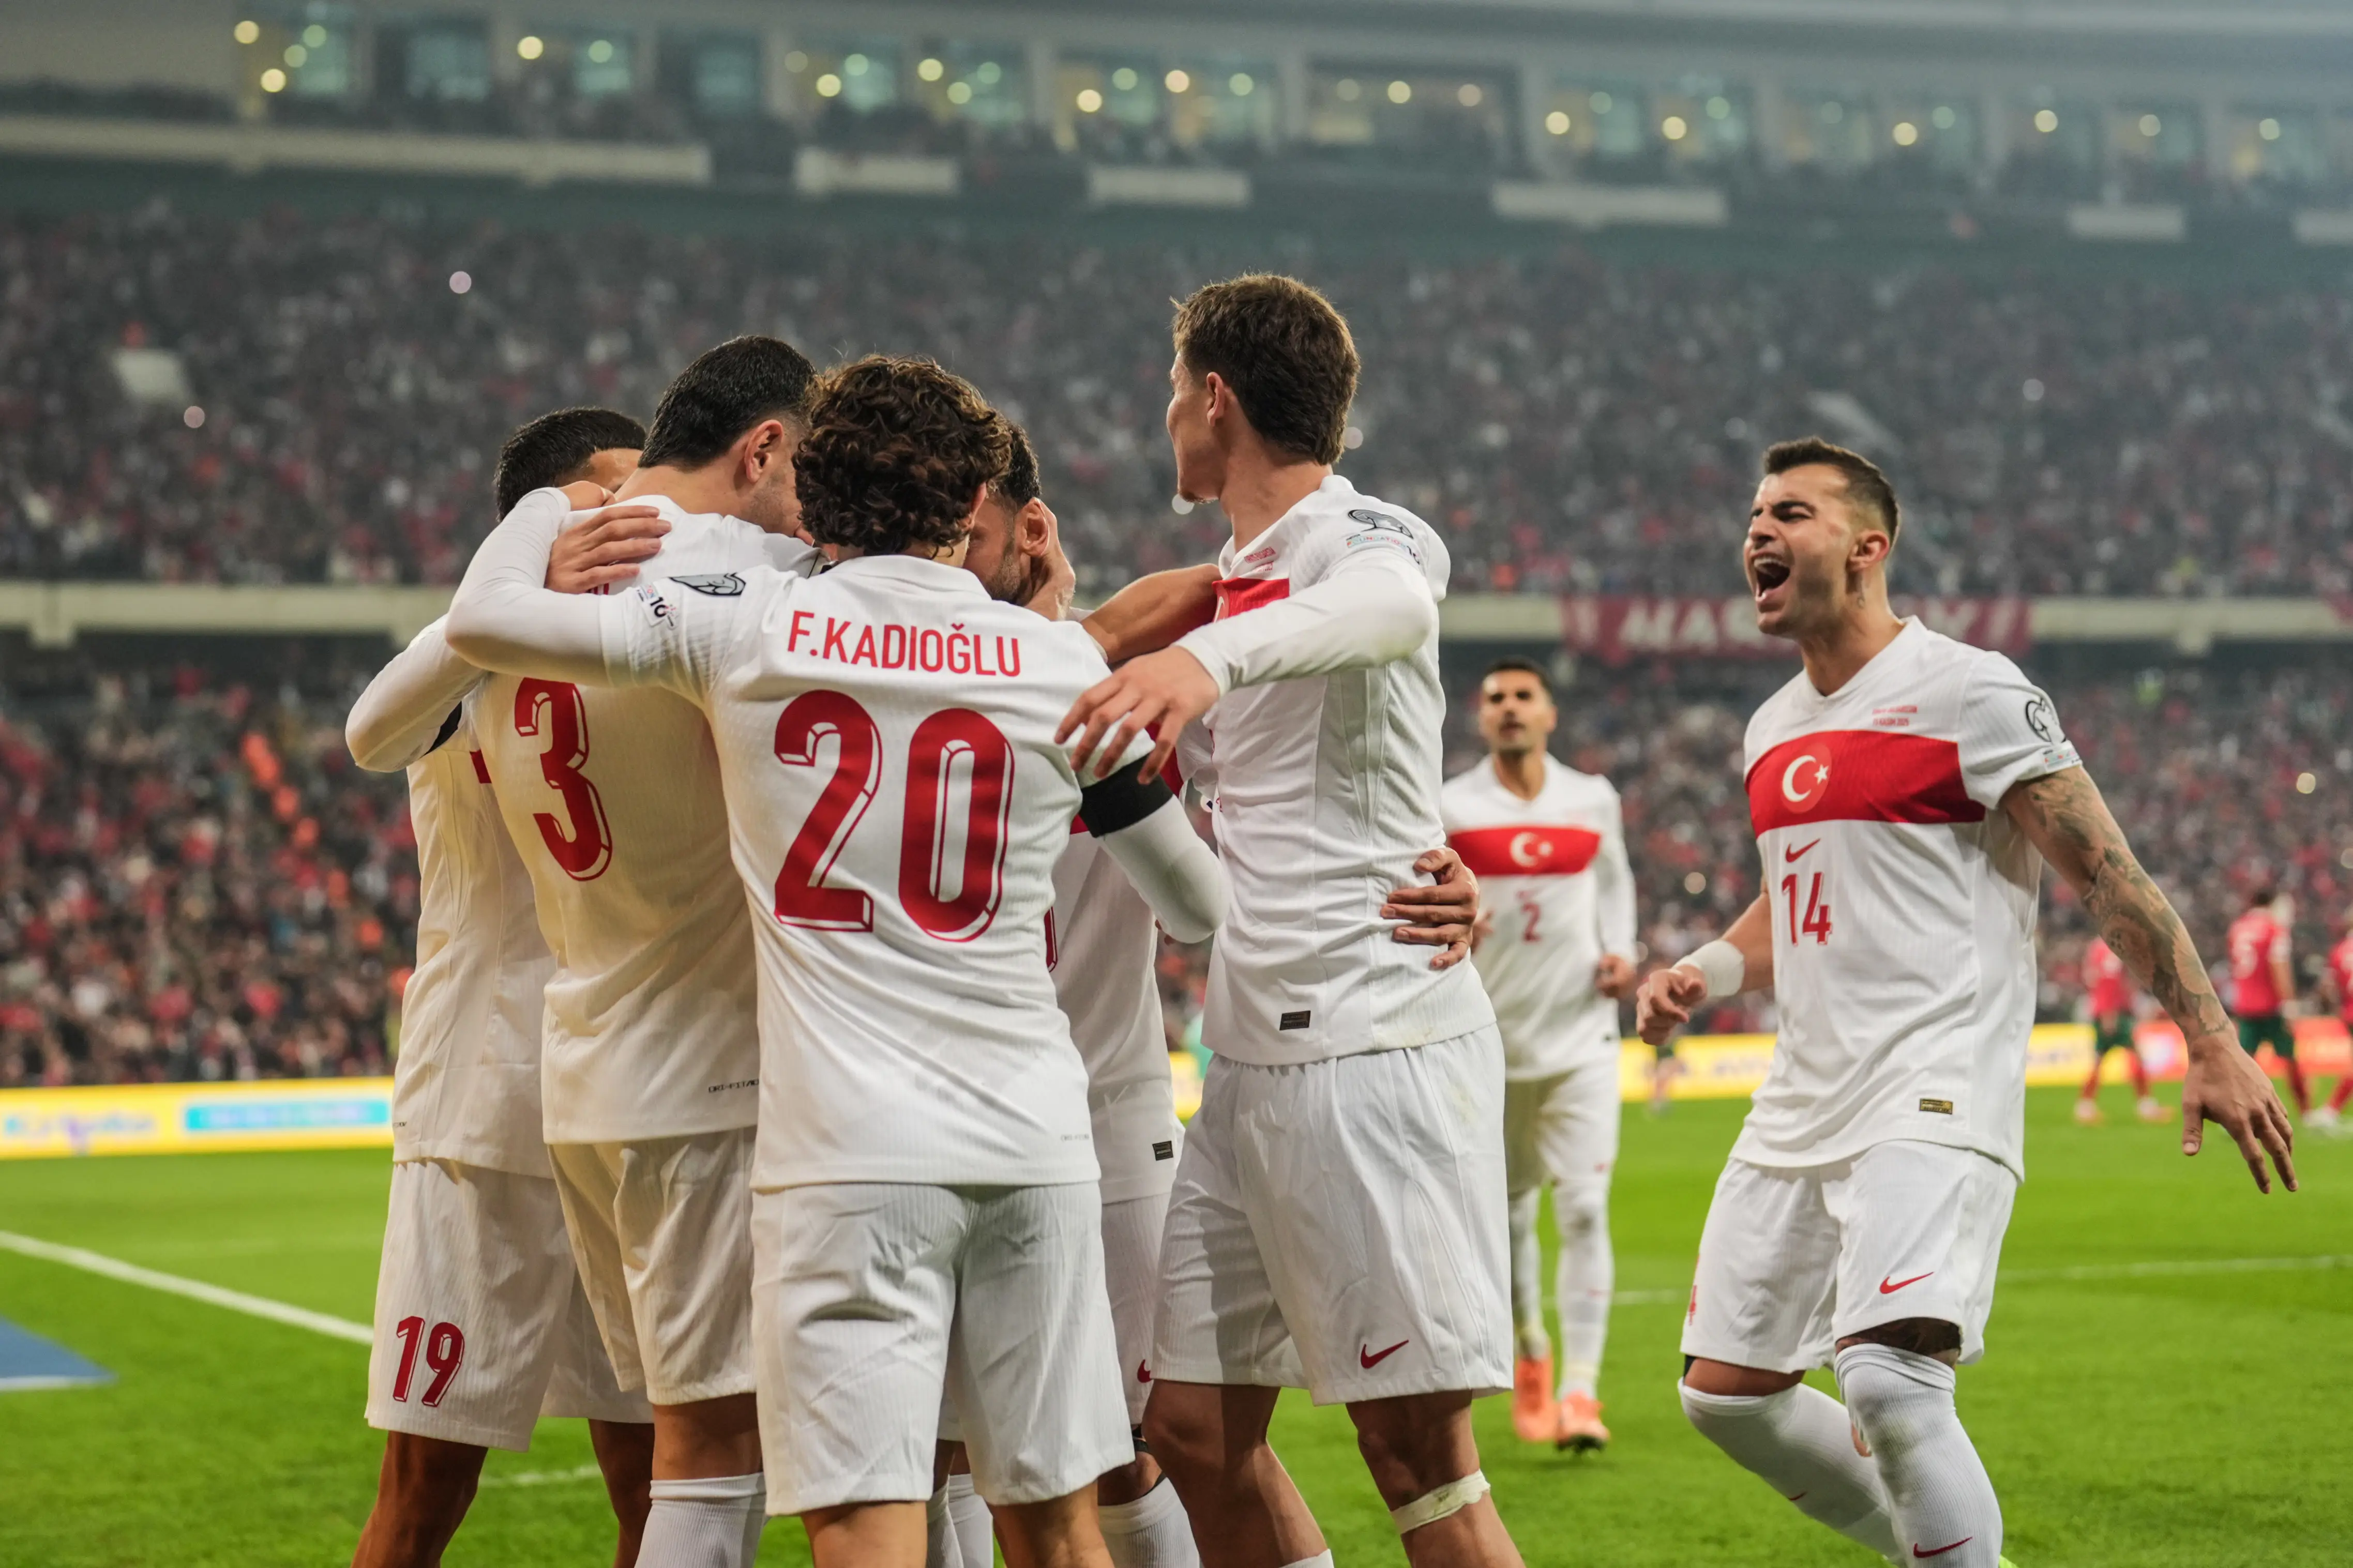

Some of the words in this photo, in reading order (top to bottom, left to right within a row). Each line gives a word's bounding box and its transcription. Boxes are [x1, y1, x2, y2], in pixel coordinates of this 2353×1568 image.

[787, 610, 1021, 677] F.KADIOĞLU
[514, 677, 613, 881] 3
[774, 689, 1015, 942] 20
[1520, 902, 1542, 943] 2
[1782, 872, 1833, 947] 14
[393, 1316, 465, 1407] 19
